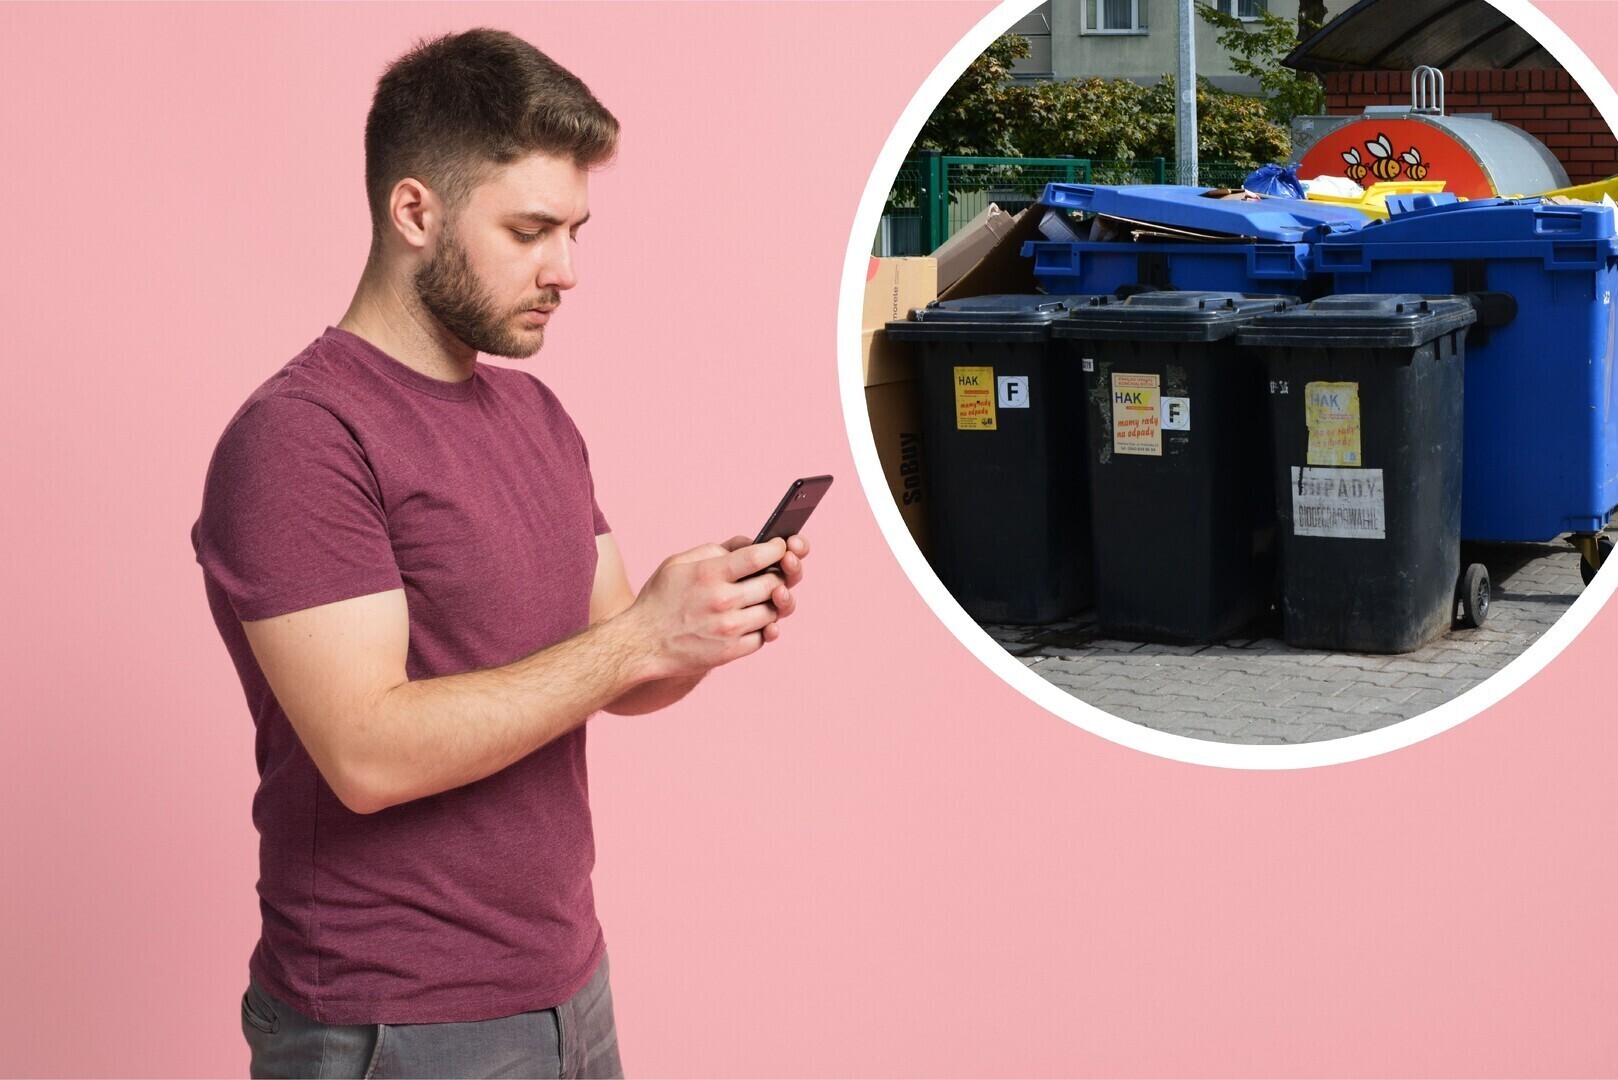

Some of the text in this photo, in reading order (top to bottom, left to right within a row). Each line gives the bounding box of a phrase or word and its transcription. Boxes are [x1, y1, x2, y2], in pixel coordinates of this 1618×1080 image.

[958, 376, 979, 386] HAK
[1007, 382, 1018, 401] F
[1115, 392, 1142, 404] HAK
[1310, 394, 1339, 408] HAK
[1169, 403, 1180, 423] F
[1117, 415, 1158, 428] mamy rady
[1127, 427, 1155, 438] odpady
